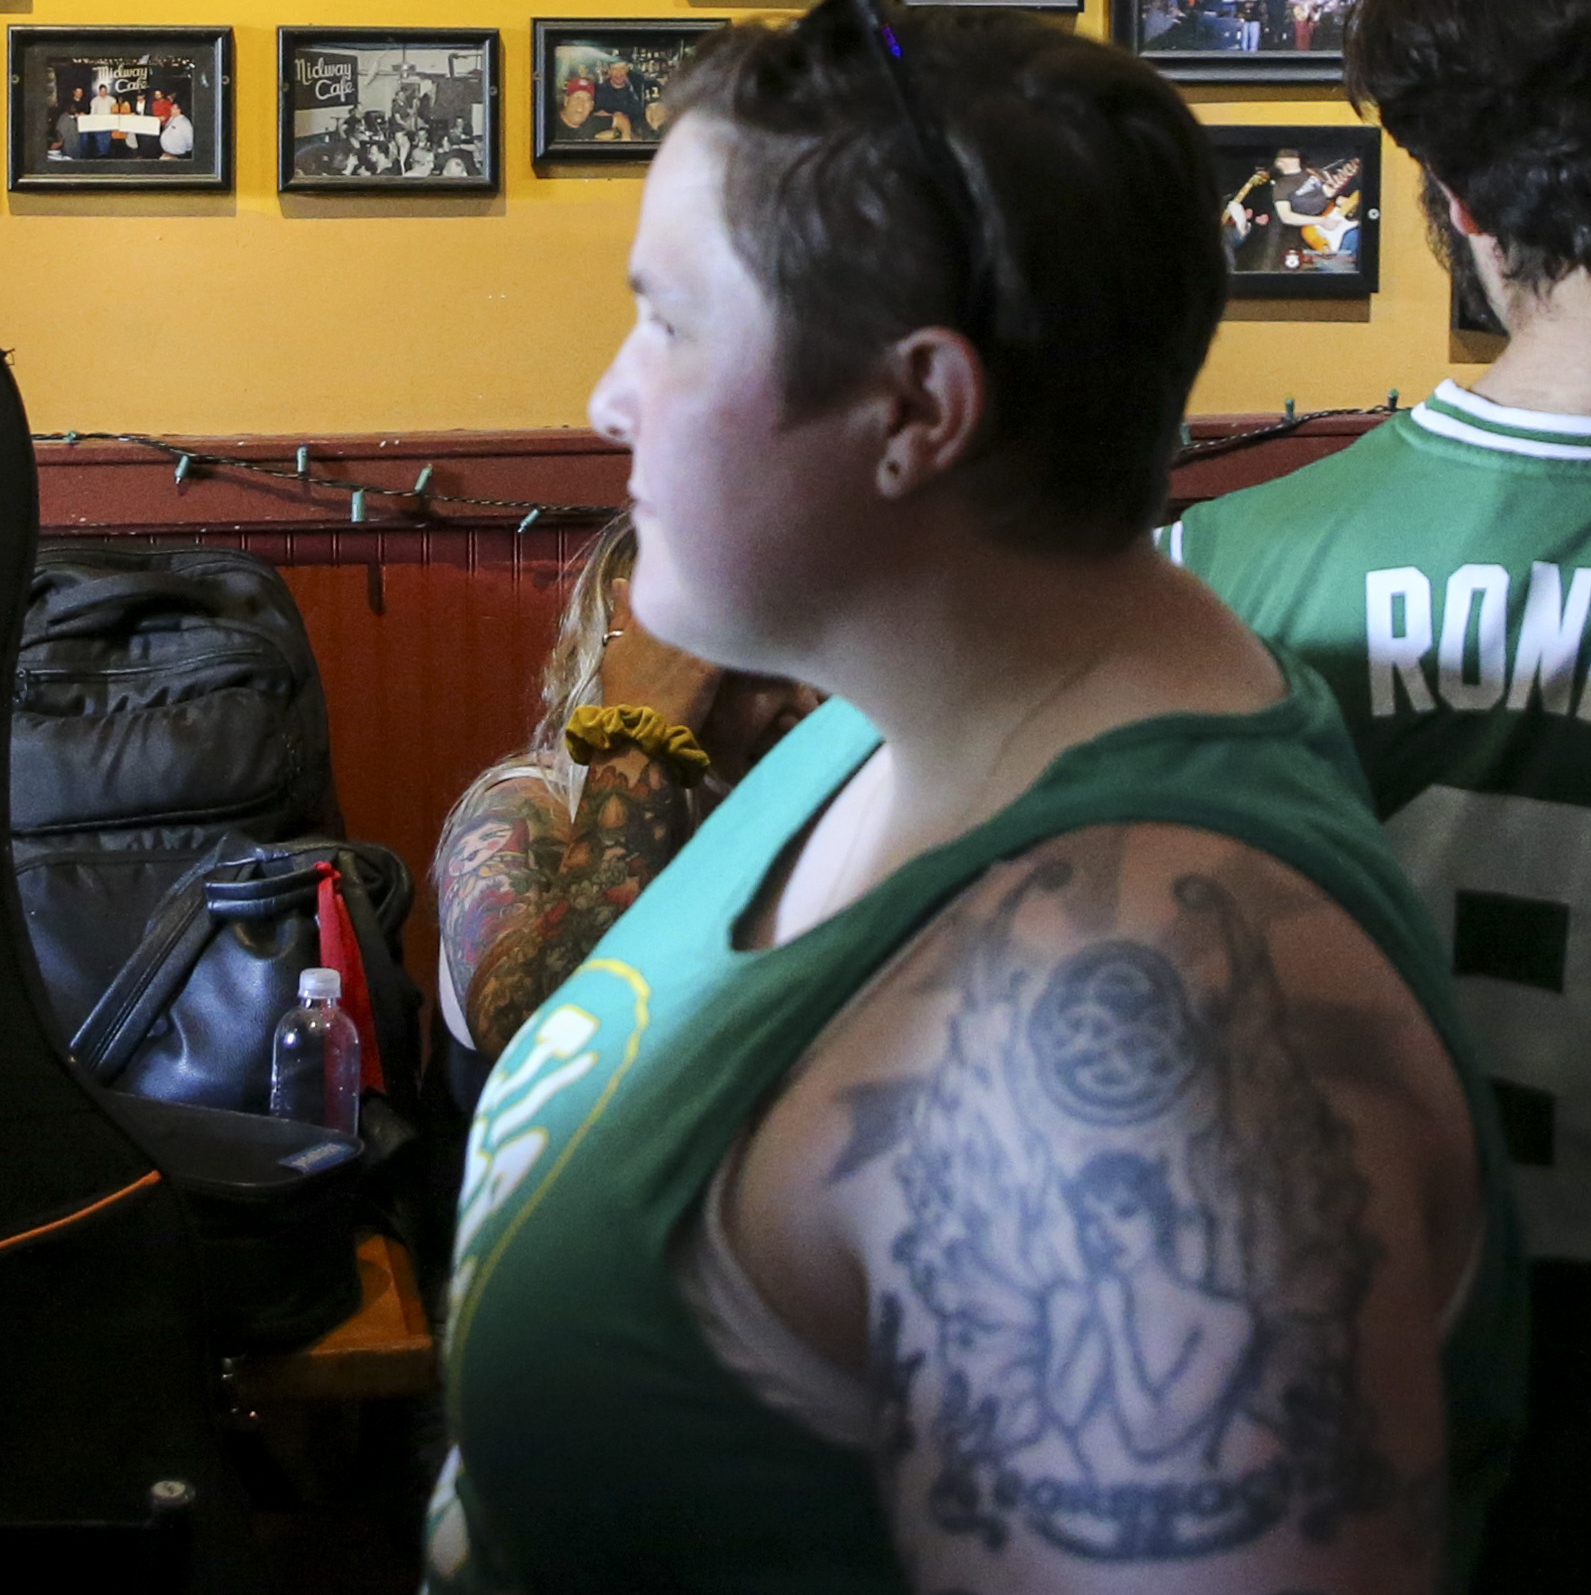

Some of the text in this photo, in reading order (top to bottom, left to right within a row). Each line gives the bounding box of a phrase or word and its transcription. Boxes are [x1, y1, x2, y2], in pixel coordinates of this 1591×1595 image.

[91, 63, 149, 83] Midway
[114, 78, 151, 94] Cafe
[314, 77, 355, 103] Cafe
